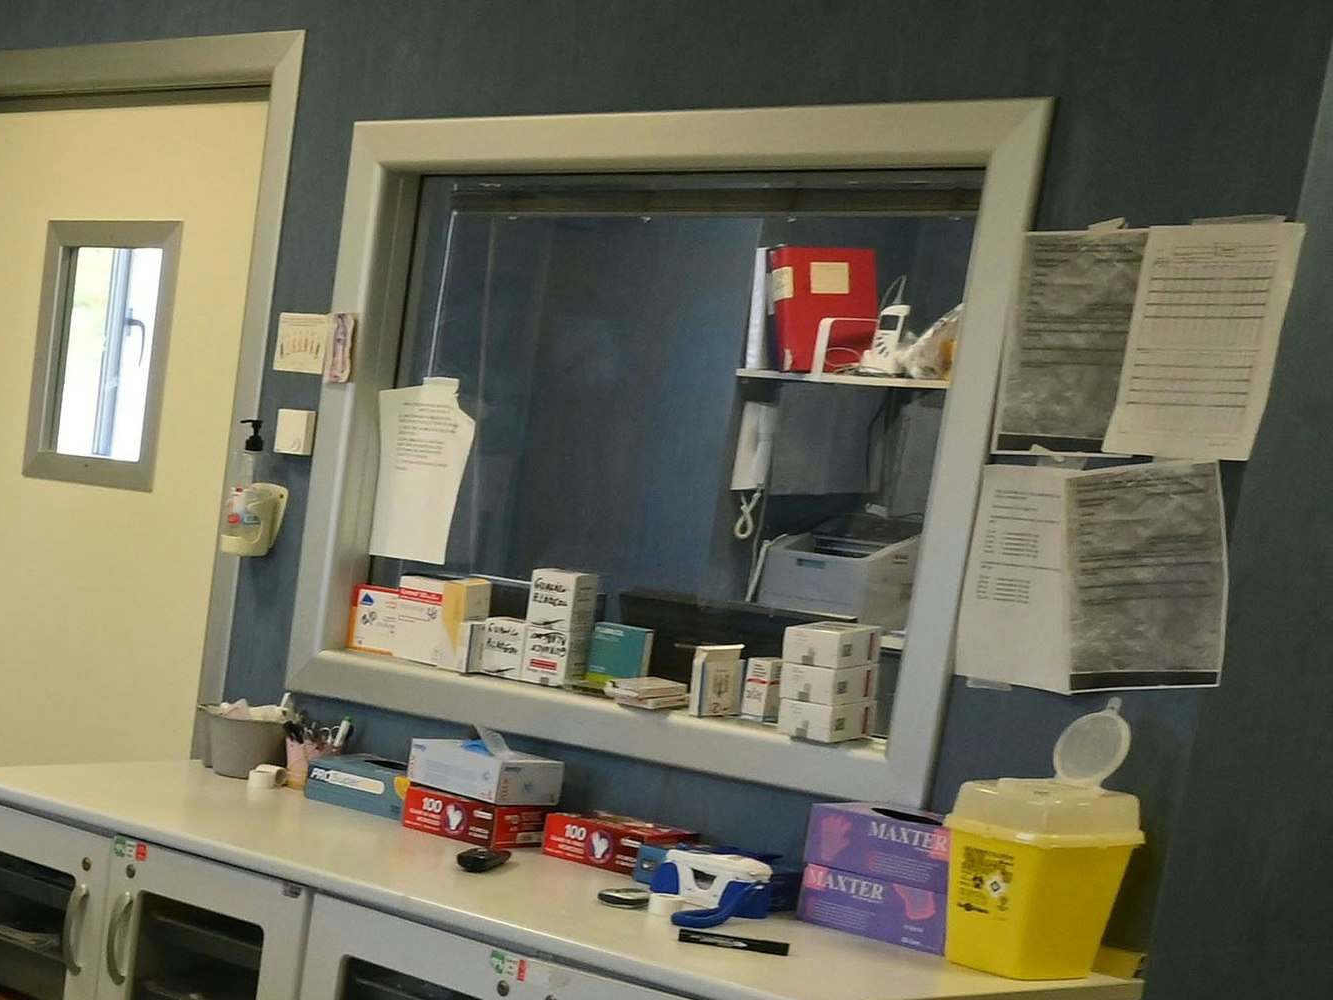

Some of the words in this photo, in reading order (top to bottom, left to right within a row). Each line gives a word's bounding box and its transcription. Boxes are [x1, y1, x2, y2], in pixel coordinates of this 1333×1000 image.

[422, 797, 443, 813] 100
[565, 823, 587, 841] 100
[868, 821, 948, 852] MAXTER
[806, 868, 885, 900] MAXTER
